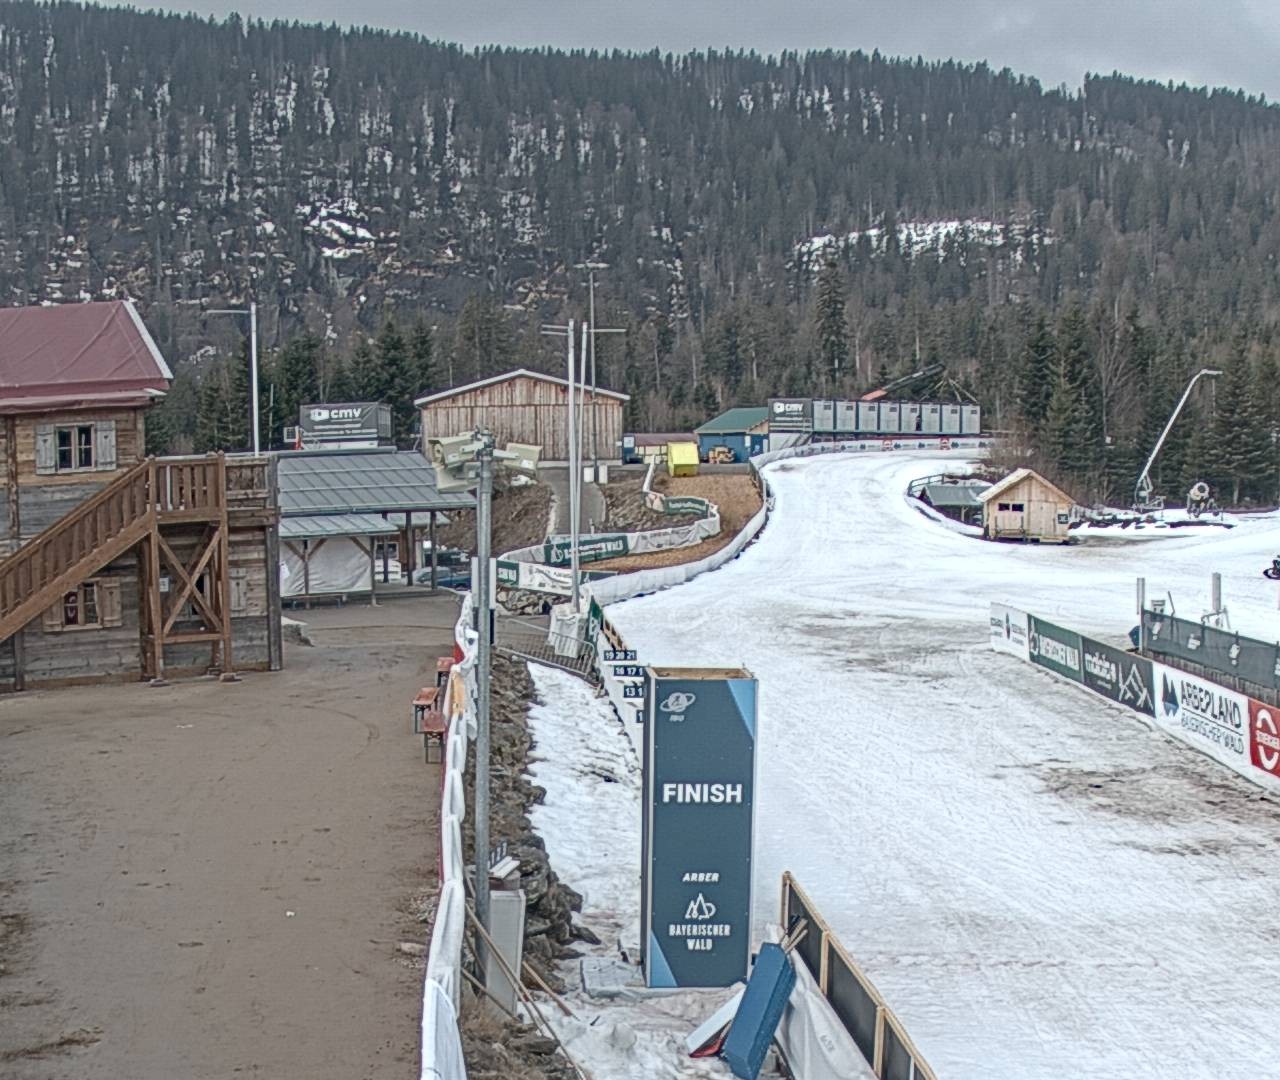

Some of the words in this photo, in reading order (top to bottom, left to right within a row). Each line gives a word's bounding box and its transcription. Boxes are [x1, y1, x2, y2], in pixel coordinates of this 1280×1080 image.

[330, 407, 362, 419] cmv
[1181, 680, 1242, 729] ARBERLAND
[663, 784, 743, 803] FINISH
[682, 872, 720, 882] ARBER
[668, 924, 731, 937] BAYERISCHER
[686, 938, 713, 951] WALD
